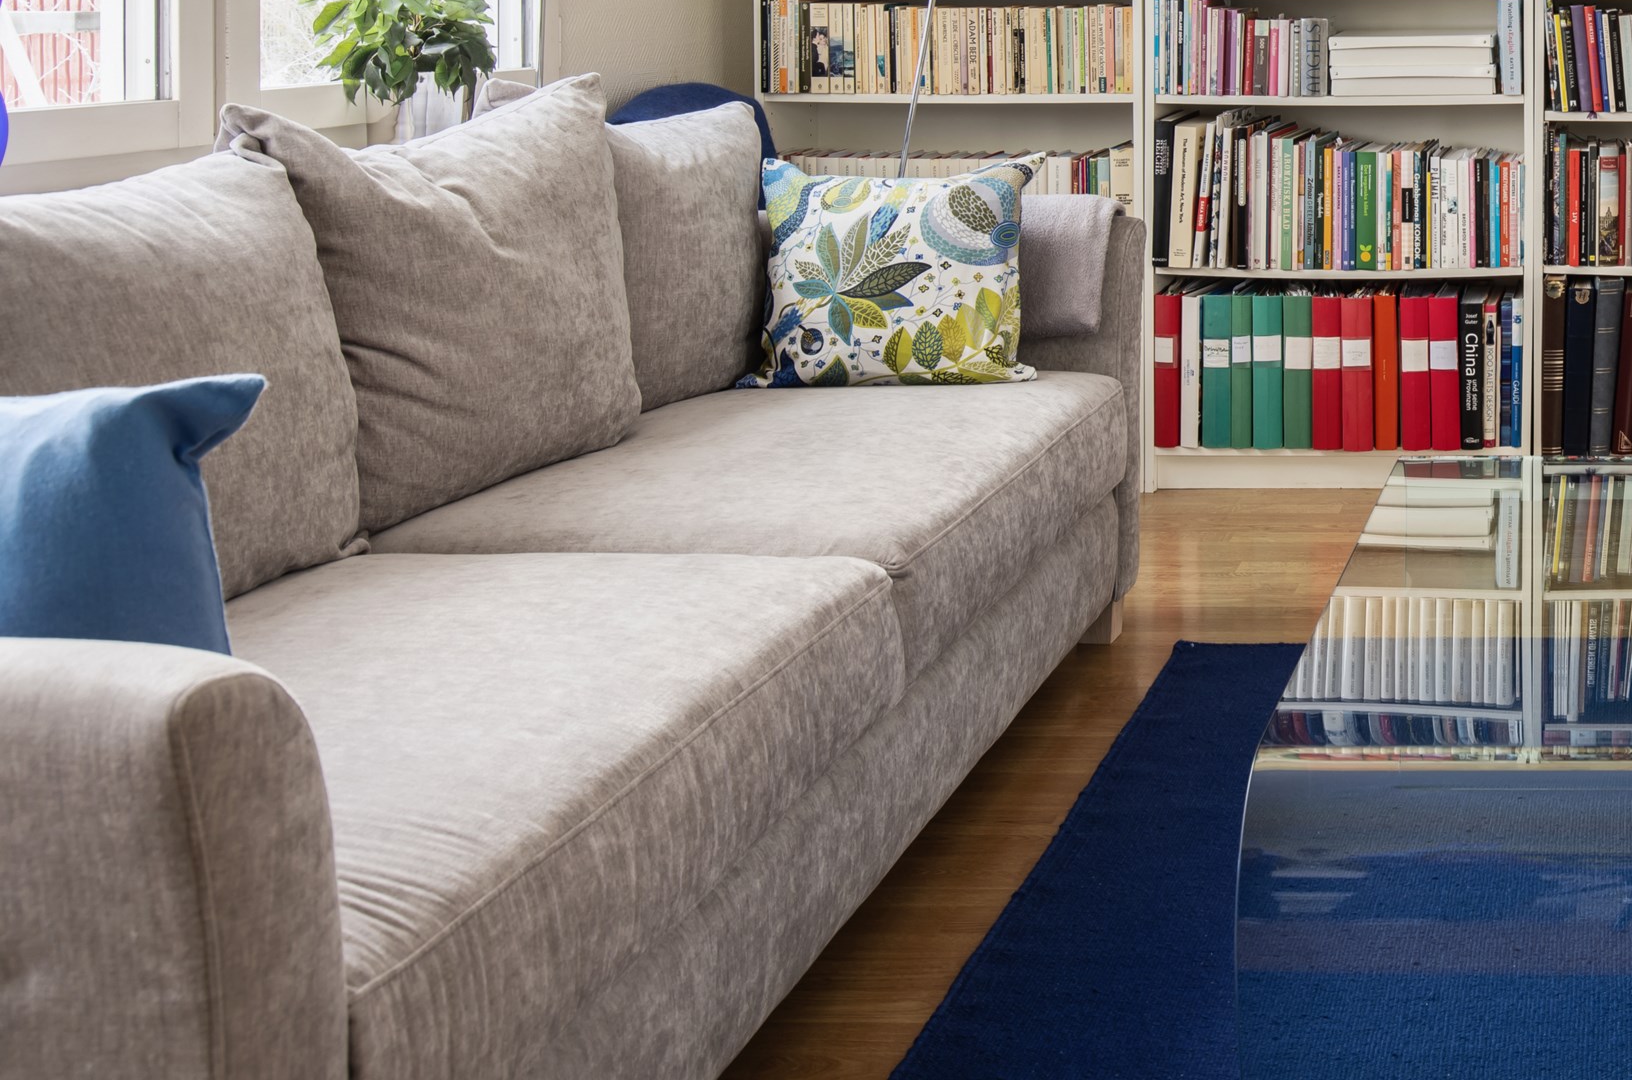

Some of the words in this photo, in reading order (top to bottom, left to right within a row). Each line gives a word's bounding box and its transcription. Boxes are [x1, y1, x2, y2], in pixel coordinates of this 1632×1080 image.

[1565, 30, 1573, 58] BÄTTRE
[1306, 24, 1321, 93] ANGELS
[1567, 61, 1576, 88] ENGELSKA
[1283, 153, 1291, 205] AROMATISKA
[1306, 178, 1314, 199] Zeinas
[1431, 168, 1440, 200] PLÅTMAT
[1283, 208, 1291, 229] BLAD
[1306, 200, 1314, 222] GREEN
[1306, 222, 1314, 245] kitchen
[1465, 333, 1478, 376] China
[1486, 347, 1494, 393] 1900-TALETS
[1486, 395, 1494, 421] DESIGN
